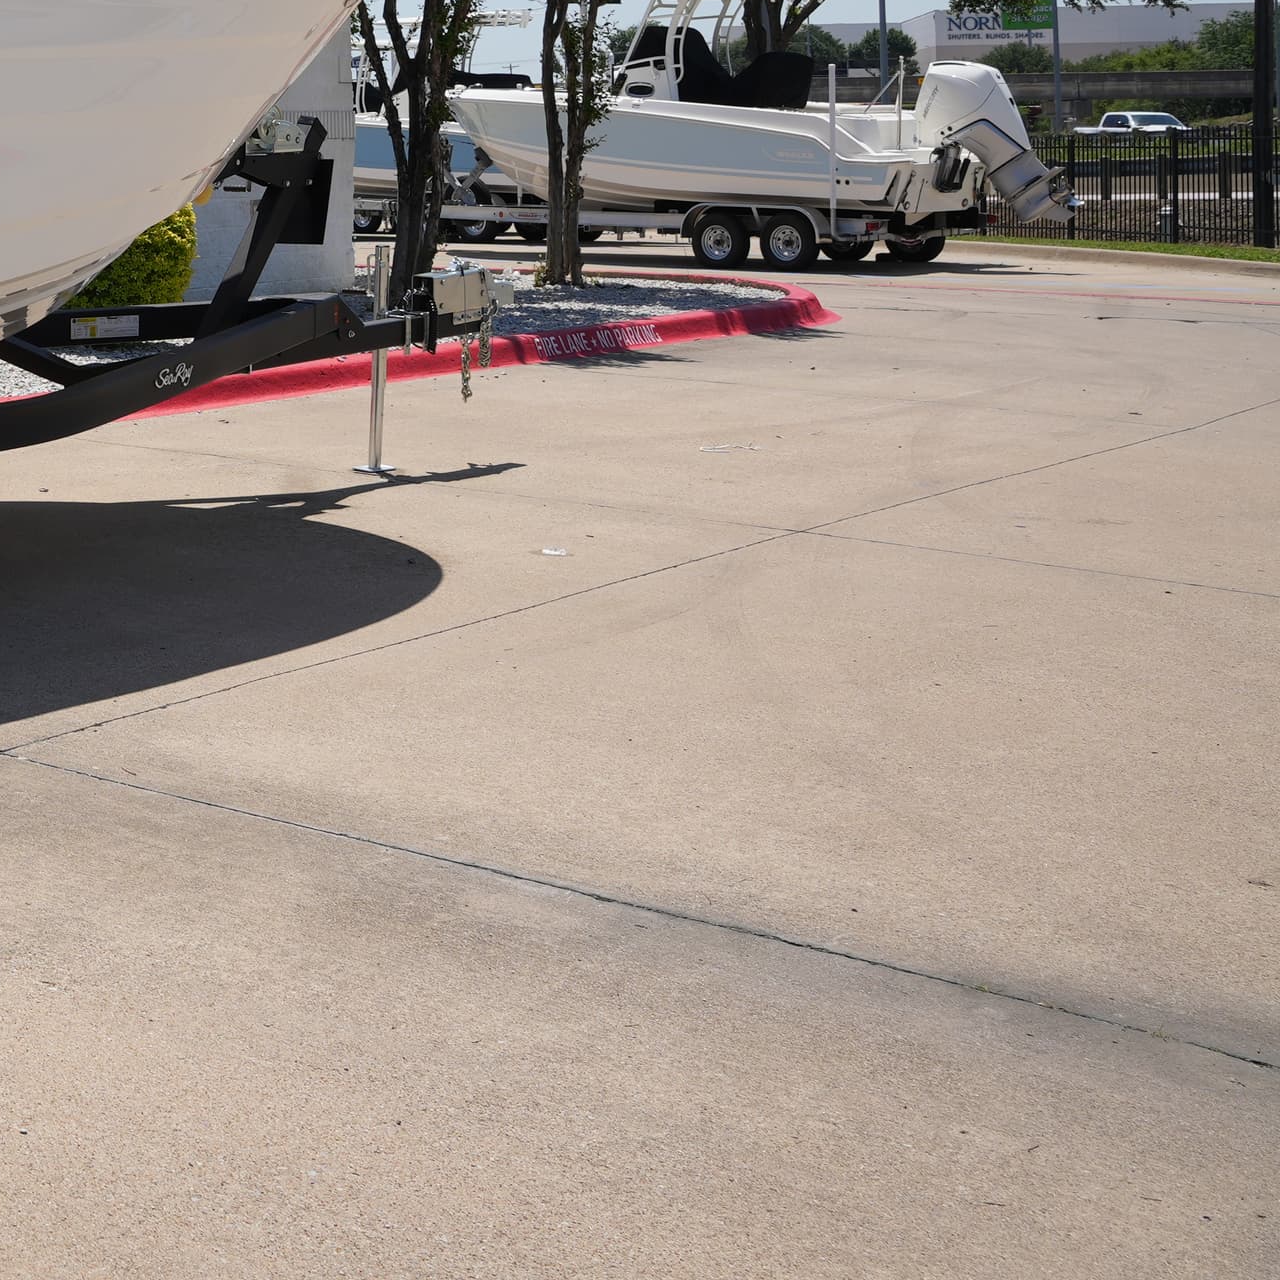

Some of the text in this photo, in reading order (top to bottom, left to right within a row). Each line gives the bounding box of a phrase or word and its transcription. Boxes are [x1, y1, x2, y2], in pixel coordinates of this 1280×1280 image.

[534, 324, 663, 358] FIRE LANE NO PARKING
